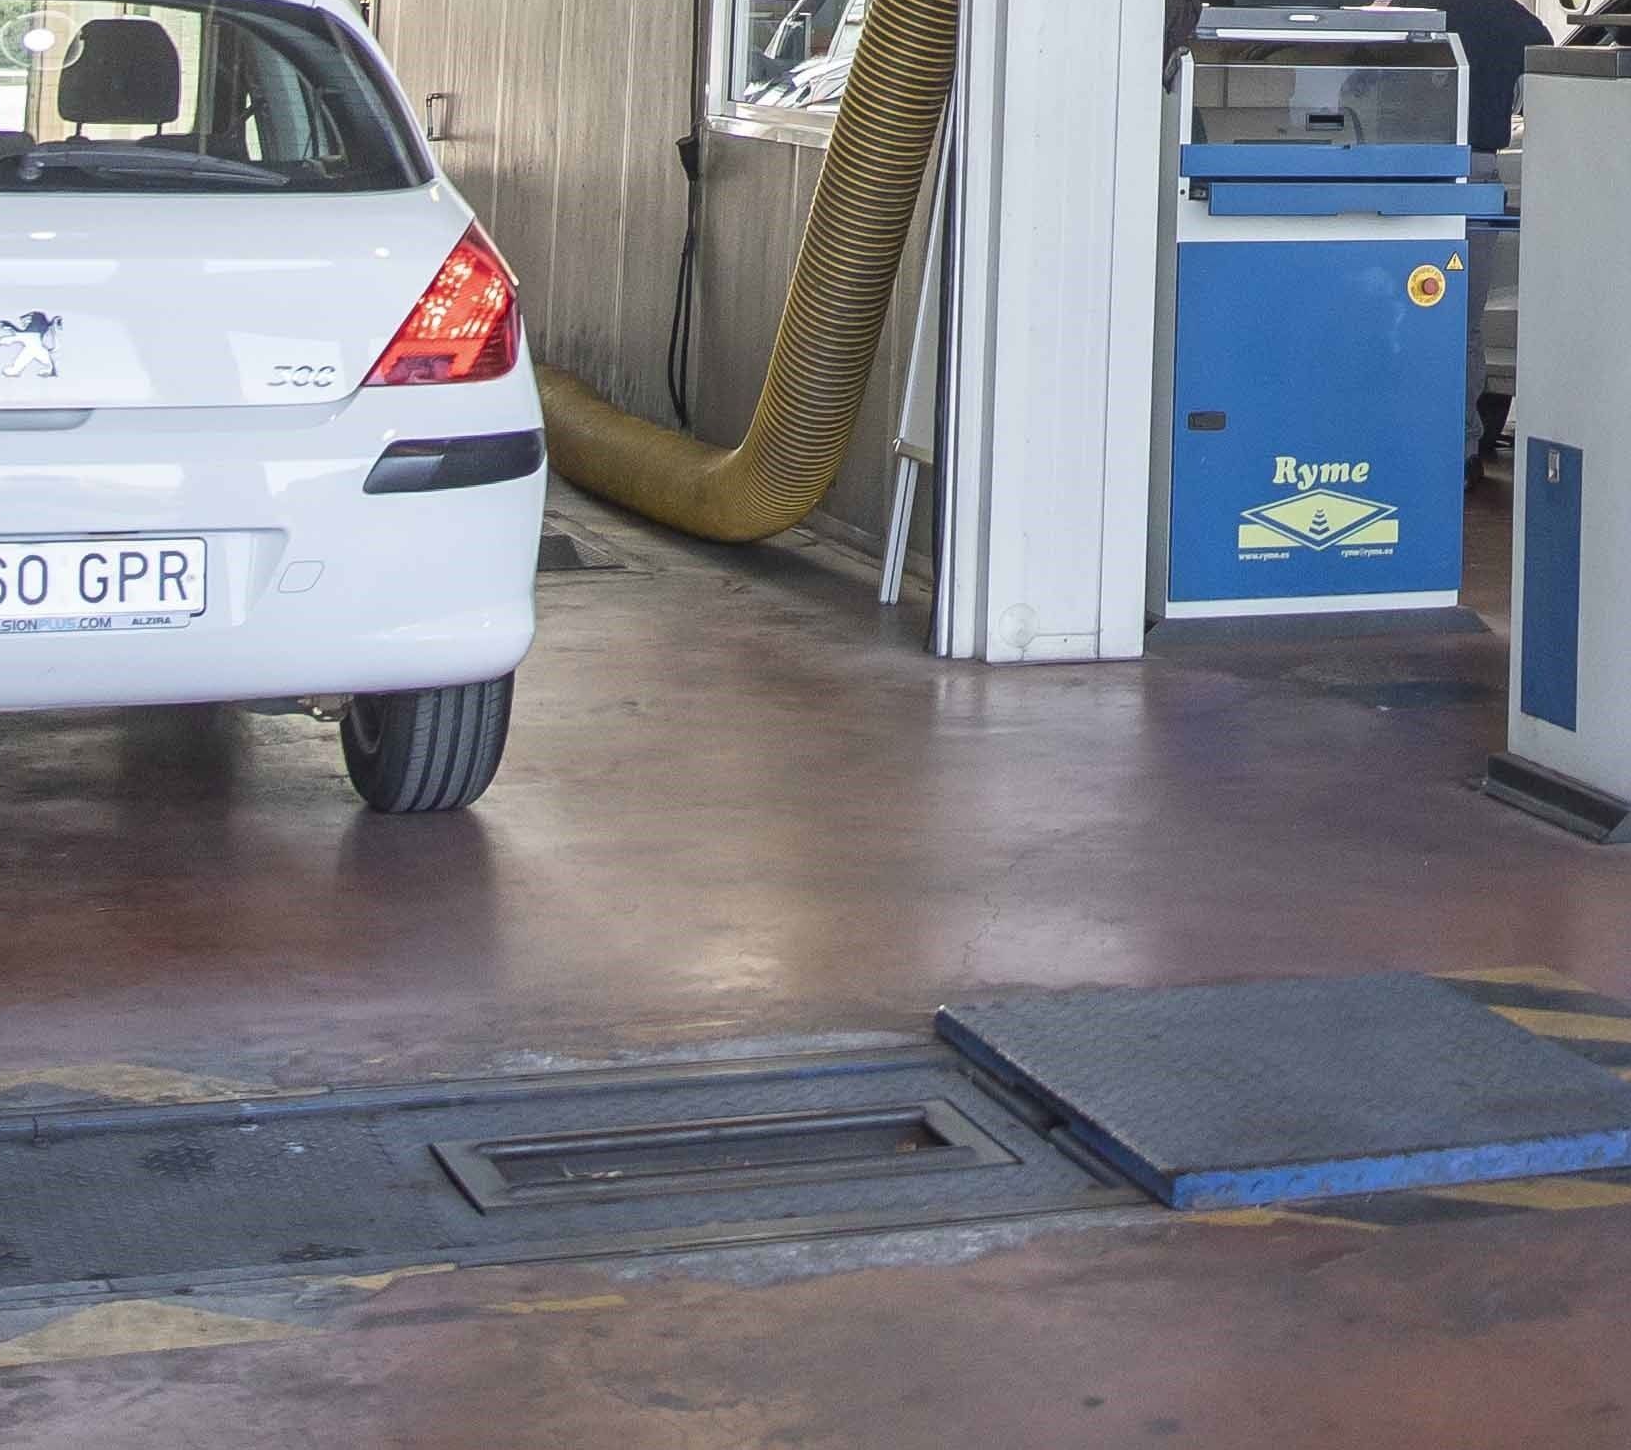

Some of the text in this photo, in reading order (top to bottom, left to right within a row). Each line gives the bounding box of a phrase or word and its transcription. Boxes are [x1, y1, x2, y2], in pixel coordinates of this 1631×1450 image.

[1272, 456, 1370, 490] Ryme
[78, 549, 189, 604] GPR
[131, 616, 172, 627] ALZIRA
